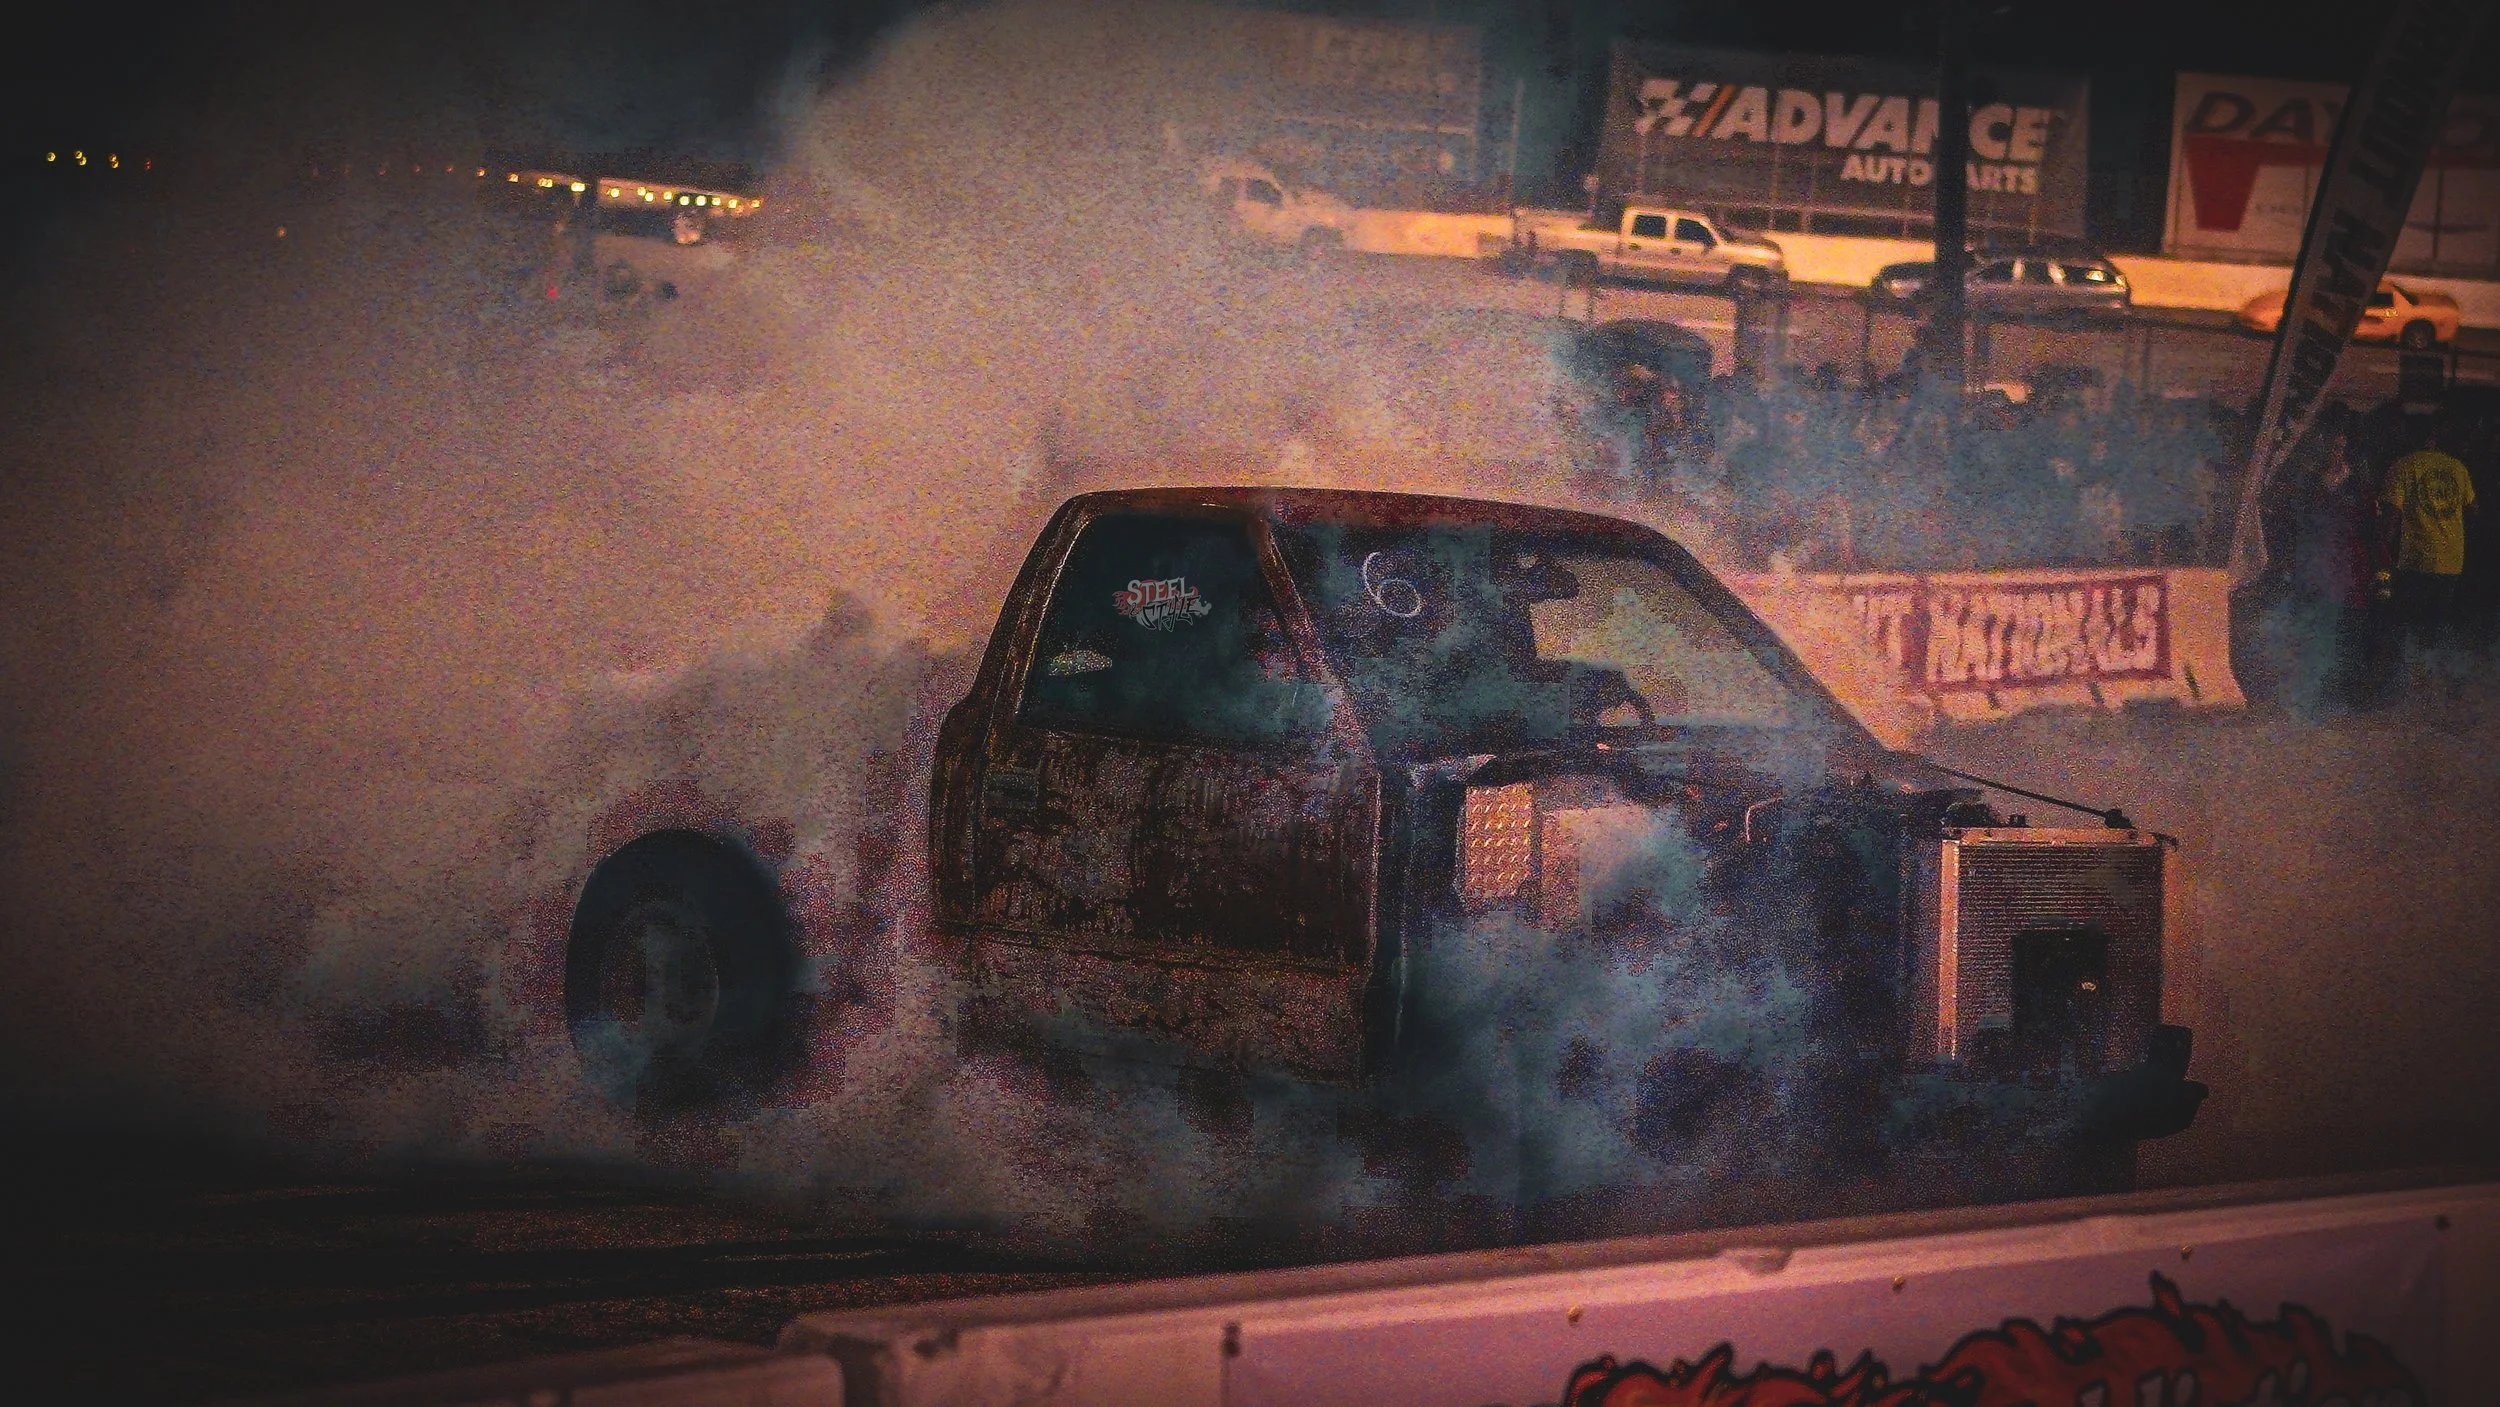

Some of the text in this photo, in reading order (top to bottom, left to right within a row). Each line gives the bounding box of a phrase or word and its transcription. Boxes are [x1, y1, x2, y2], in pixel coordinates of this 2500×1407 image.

[1839, 153, 2040, 195] AUTO ARTS
[1127, 576, 1197, 606] STEEL
[1362, 551, 1423, 617] 6
[1142, 595, 1201, 632] STYLE
